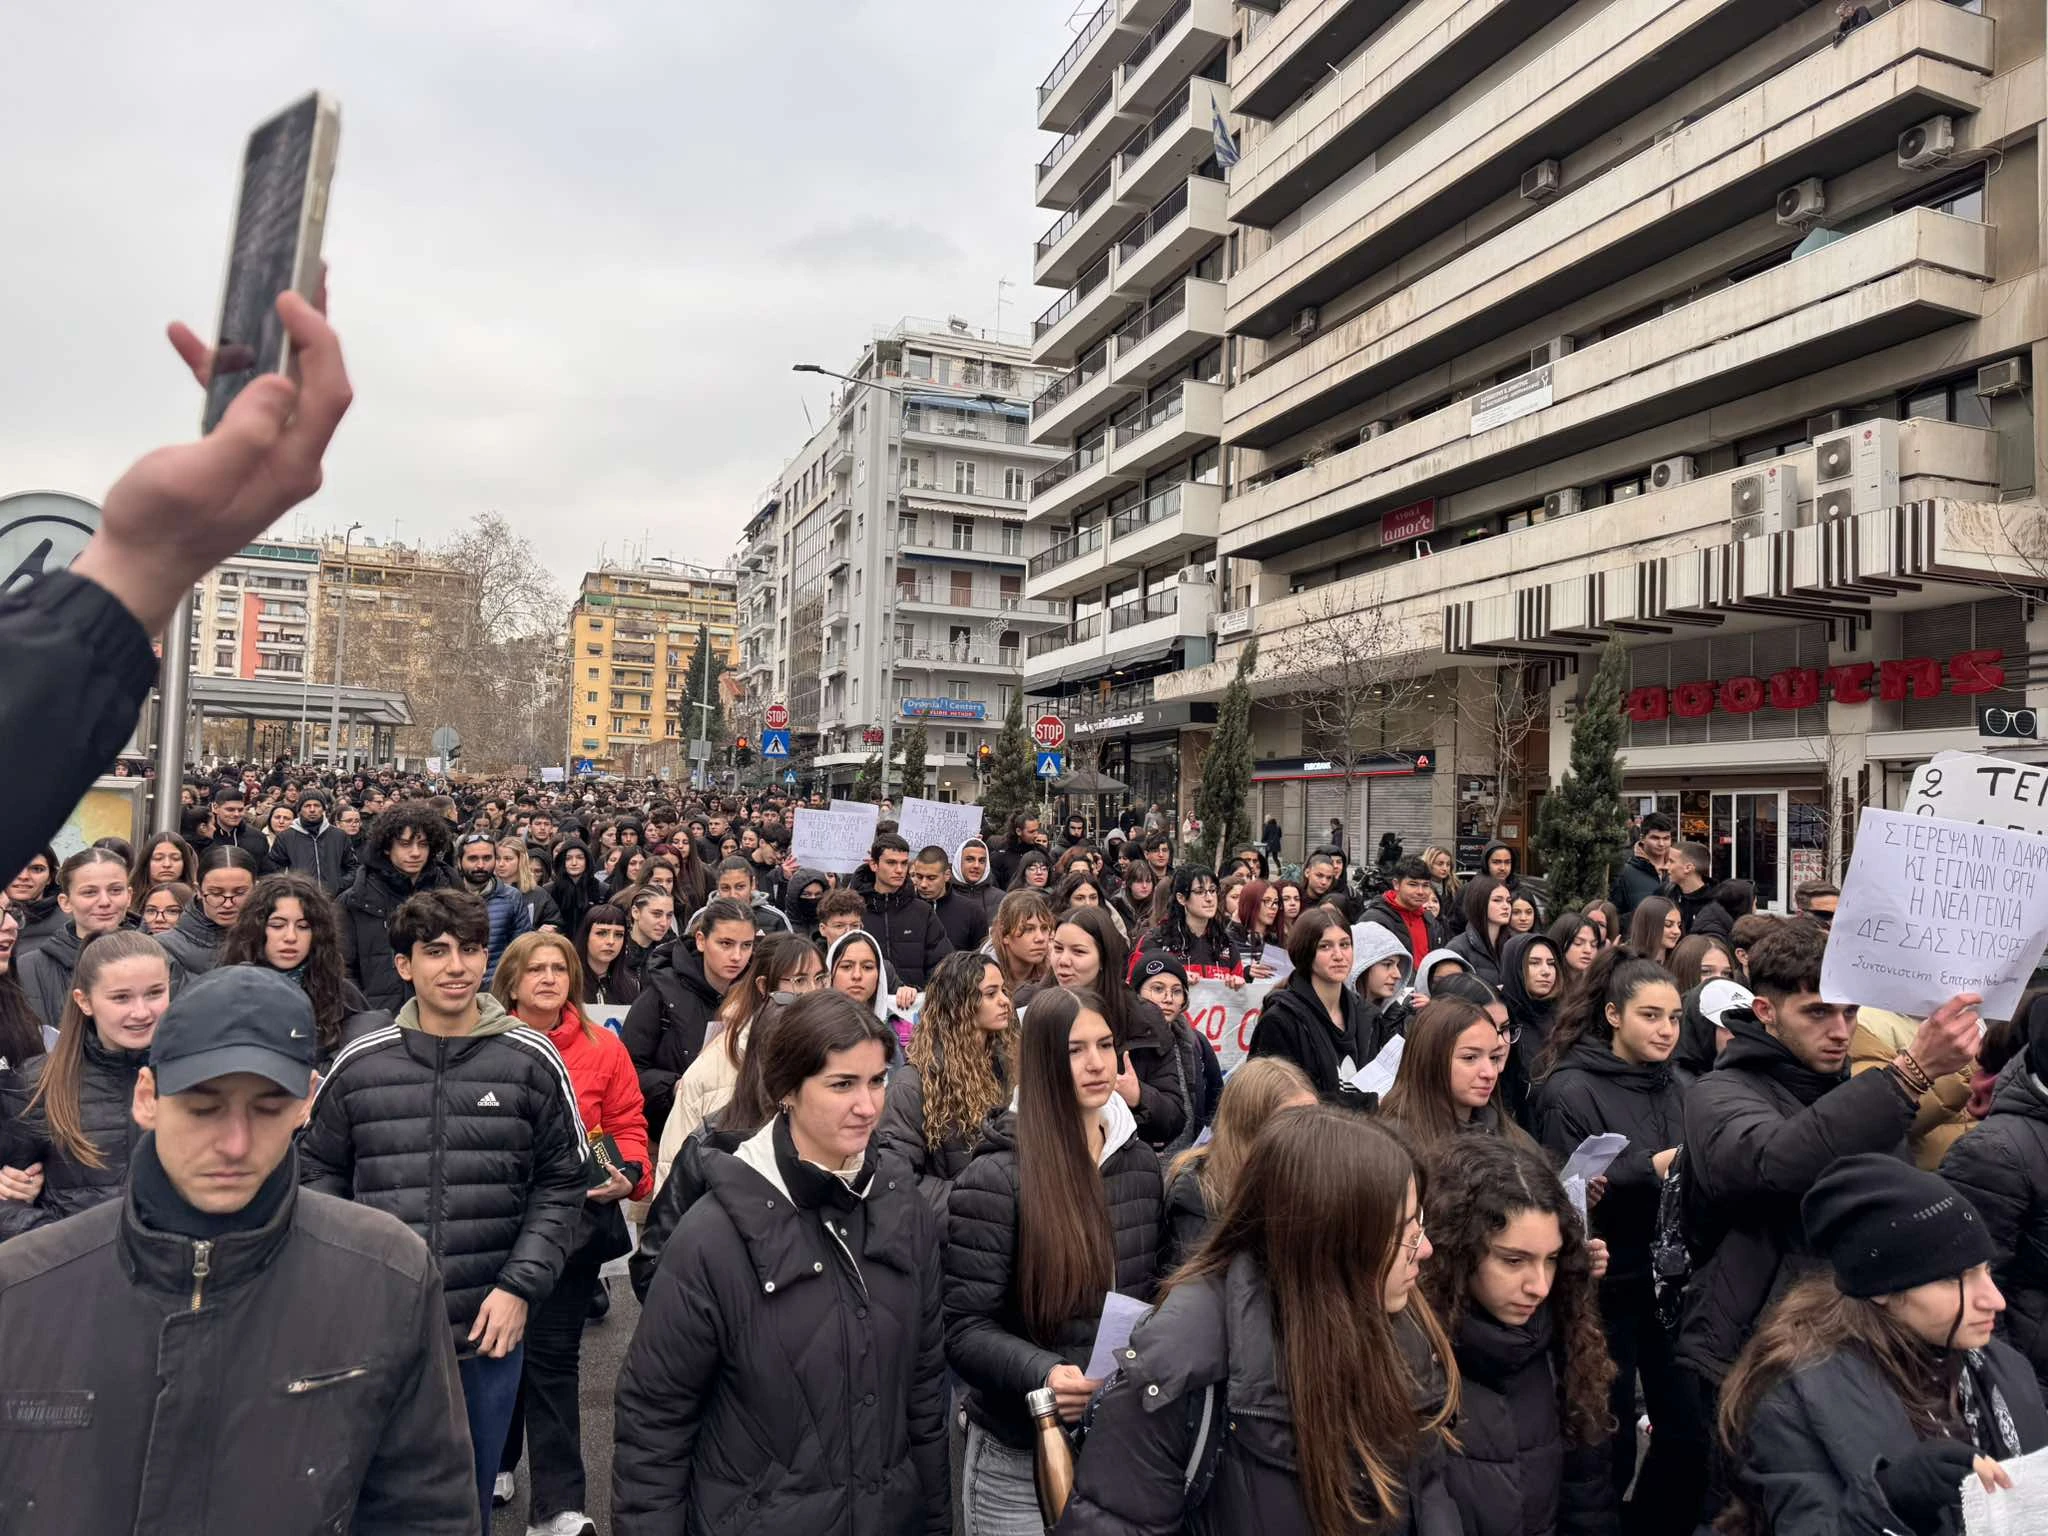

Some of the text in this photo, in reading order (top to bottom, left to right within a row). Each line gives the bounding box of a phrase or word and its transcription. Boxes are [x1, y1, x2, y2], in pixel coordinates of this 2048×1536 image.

[767, 710, 787, 723] STOP
[1036, 723, 1063, 740] STOP
[1884, 822, 1984, 859] ΣΤΕΡΕΨΑΝ
[1991, 836, 2006, 863] ΤΑ
[1904, 854, 2036, 900] ΚΙ ΕΓΙΝΑΝ ΟΡΓΗ
[1909, 886, 2023, 932] Η ΝΕΑ ΓΕΝΙΑ
[1856, 917, 1895, 943] ΔΕ
[1898, 922, 1950, 954] ΣΑΣ
